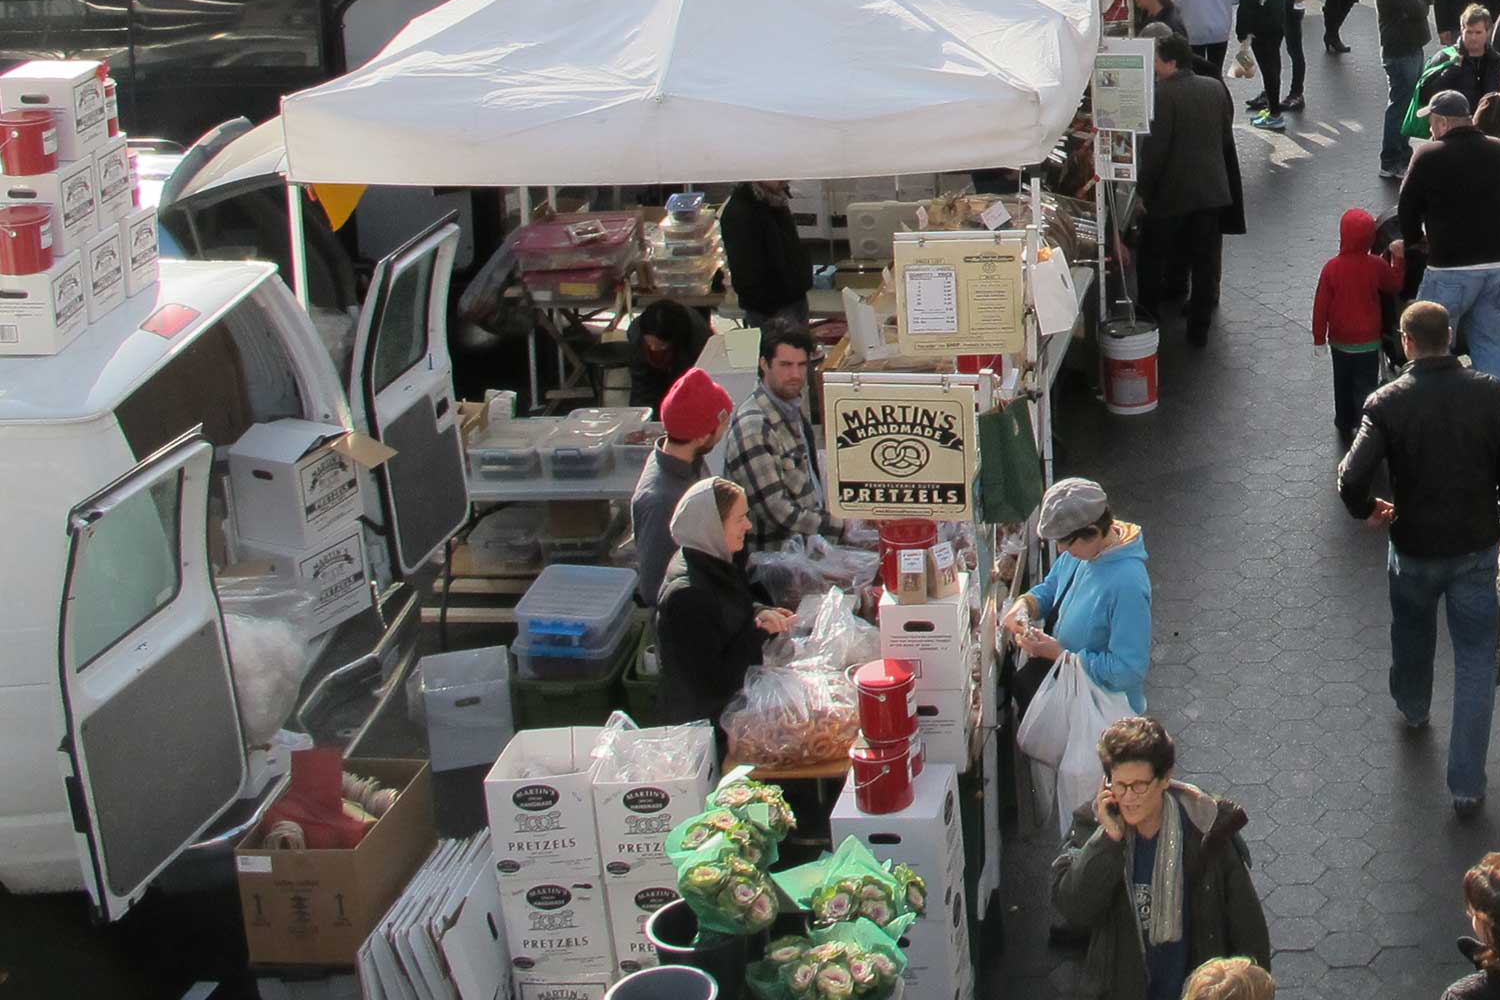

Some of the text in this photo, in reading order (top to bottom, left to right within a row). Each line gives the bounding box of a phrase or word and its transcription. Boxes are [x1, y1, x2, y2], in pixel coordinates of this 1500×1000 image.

[842, 405, 957, 431] MARTIN'S
[857, 424, 942, 440] HANDMADE
[843, 488, 958, 503] PRETZELS
[508, 838, 576, 852] PRETZELS
[618, 842, 666, 853] PRETZ
[523, 936, 589, 949] PRETZELS
